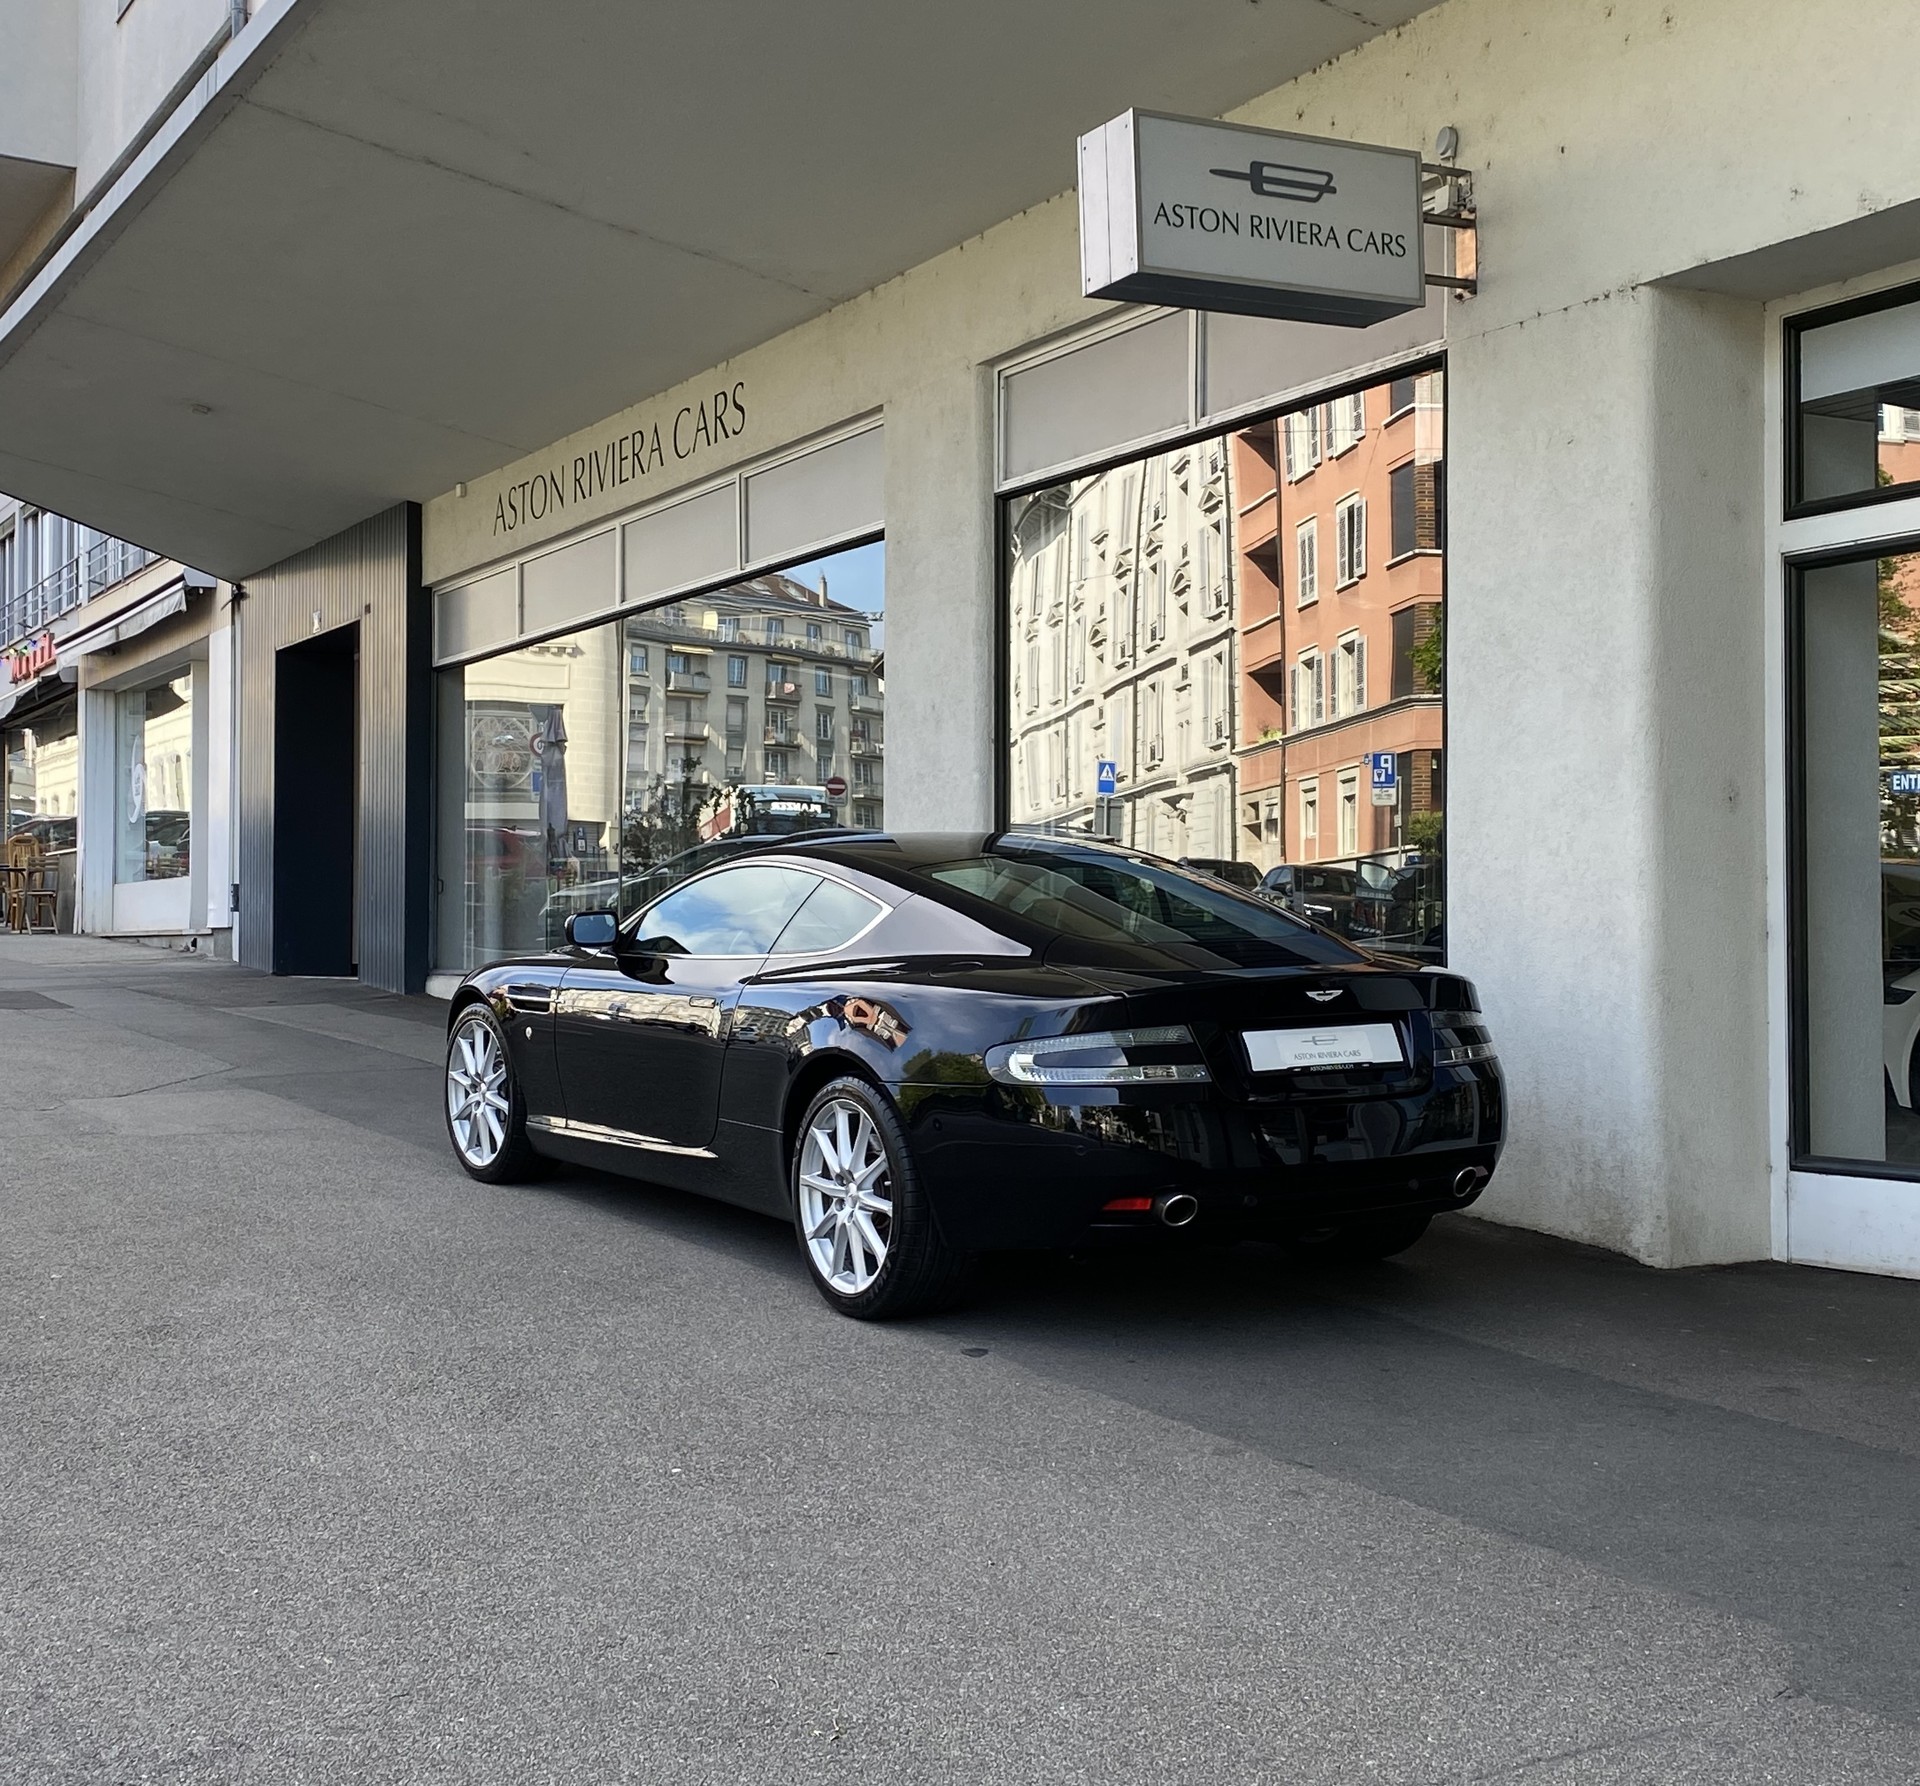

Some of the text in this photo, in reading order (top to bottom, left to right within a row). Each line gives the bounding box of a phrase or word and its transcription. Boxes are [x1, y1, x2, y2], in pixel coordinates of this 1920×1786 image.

[1153, 202, 1406, 258] ASTON RIVIERA CARS
[493, 381, 746, 536] ASTON RIVIERA CARS
[1893, 773, 1920, 790] ENT
[1294, 1049, 1361, 1061] ASTON RIVIERA CARS
